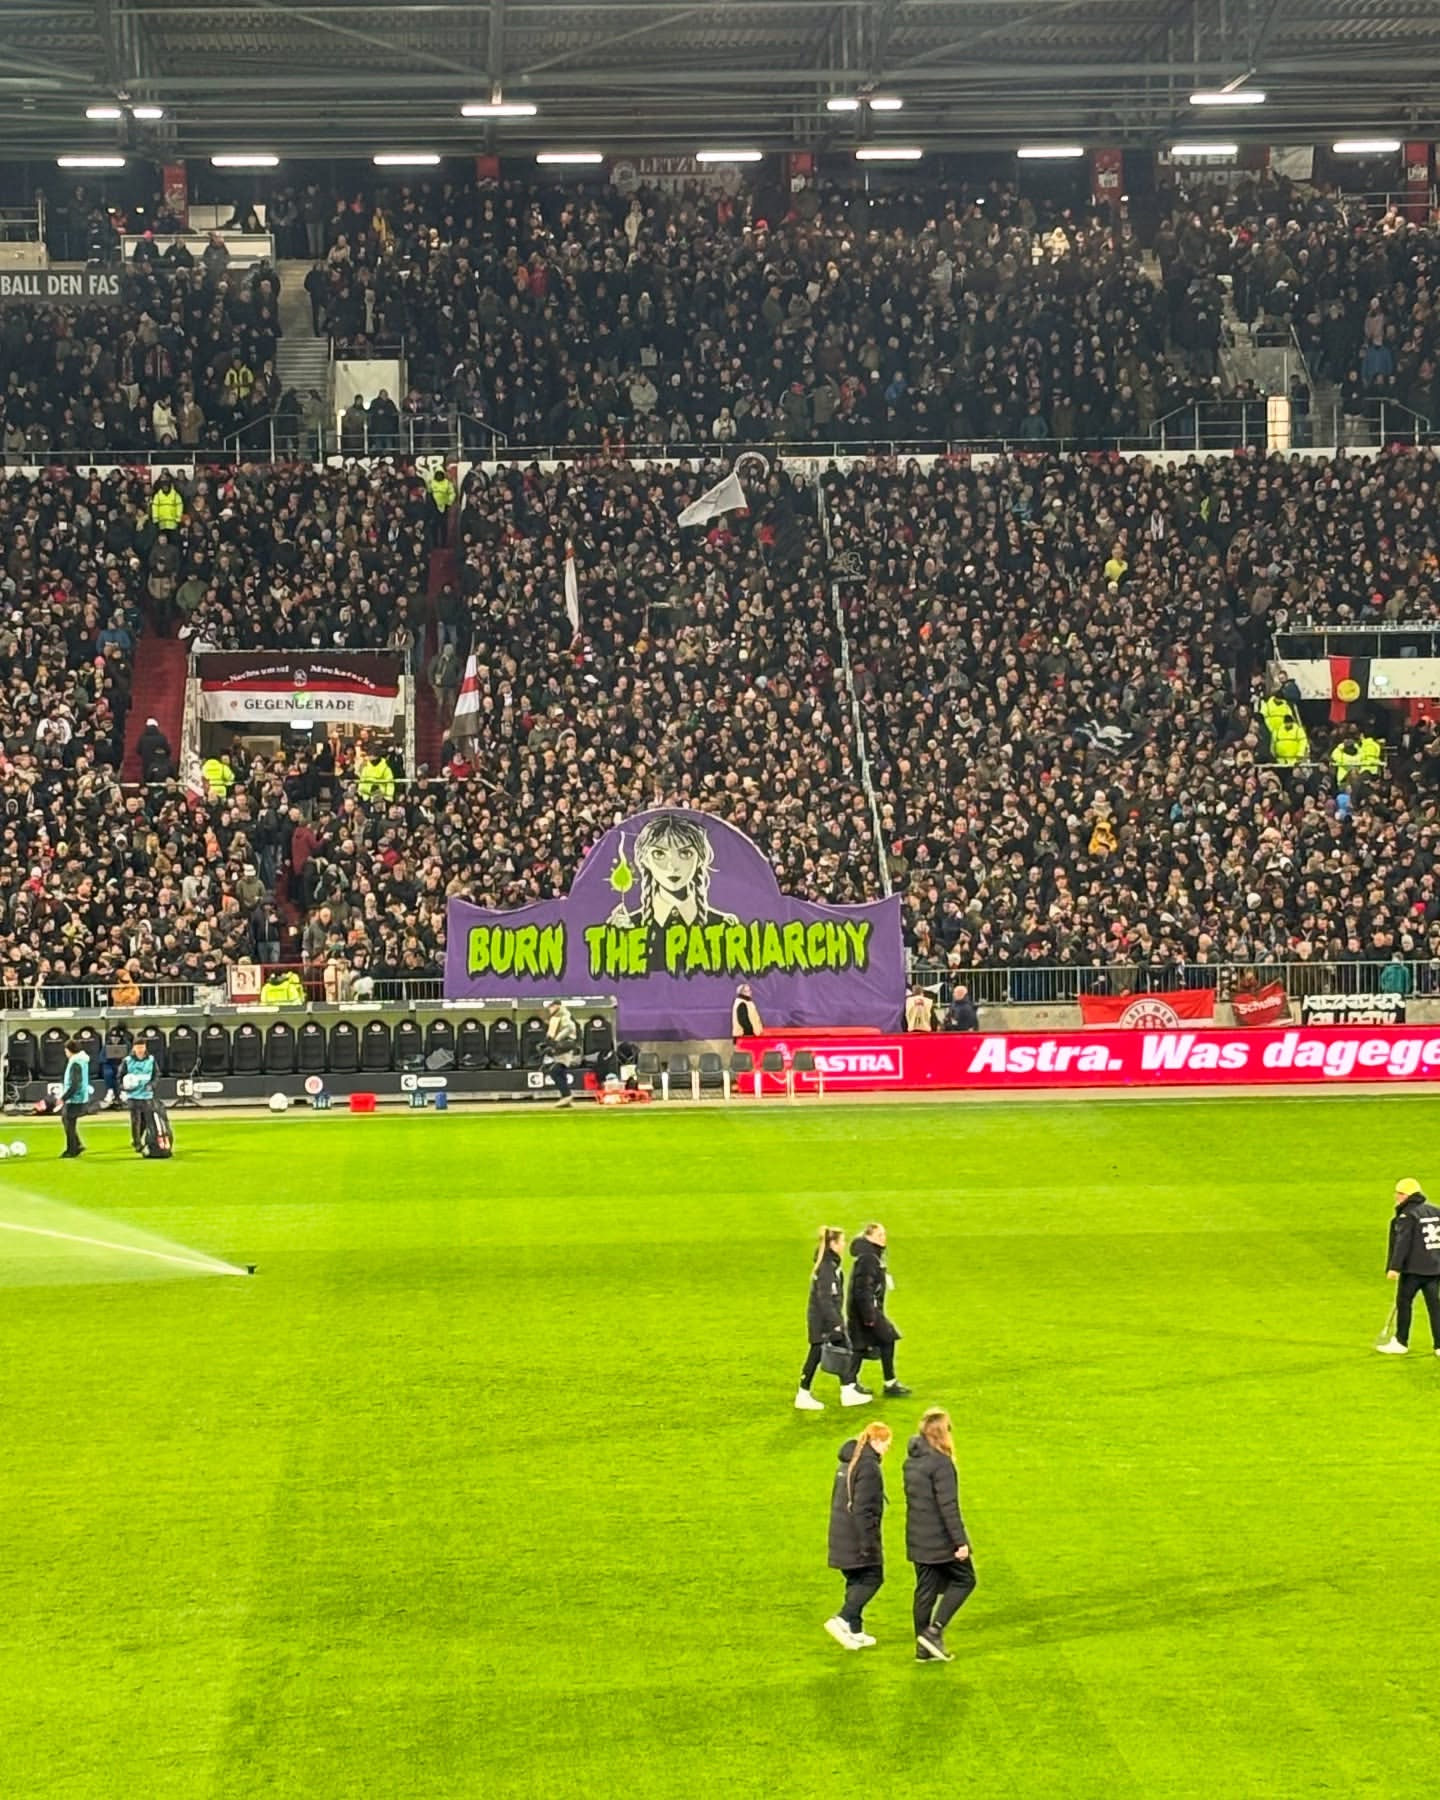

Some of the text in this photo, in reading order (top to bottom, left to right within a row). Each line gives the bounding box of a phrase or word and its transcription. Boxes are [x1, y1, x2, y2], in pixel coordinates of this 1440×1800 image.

[1, 275, 119, 296] BALL DEN FAS
[244, 698, 356, 711] GEGENGERADE
[467, 919, 870, 978] BURN THE PATRIARCHY
[814, 1054, 894, 1073] ASTRA
[967, 1036, 1123, 1073] Astra.
[1141, 1036, 1250, 1070] Was
